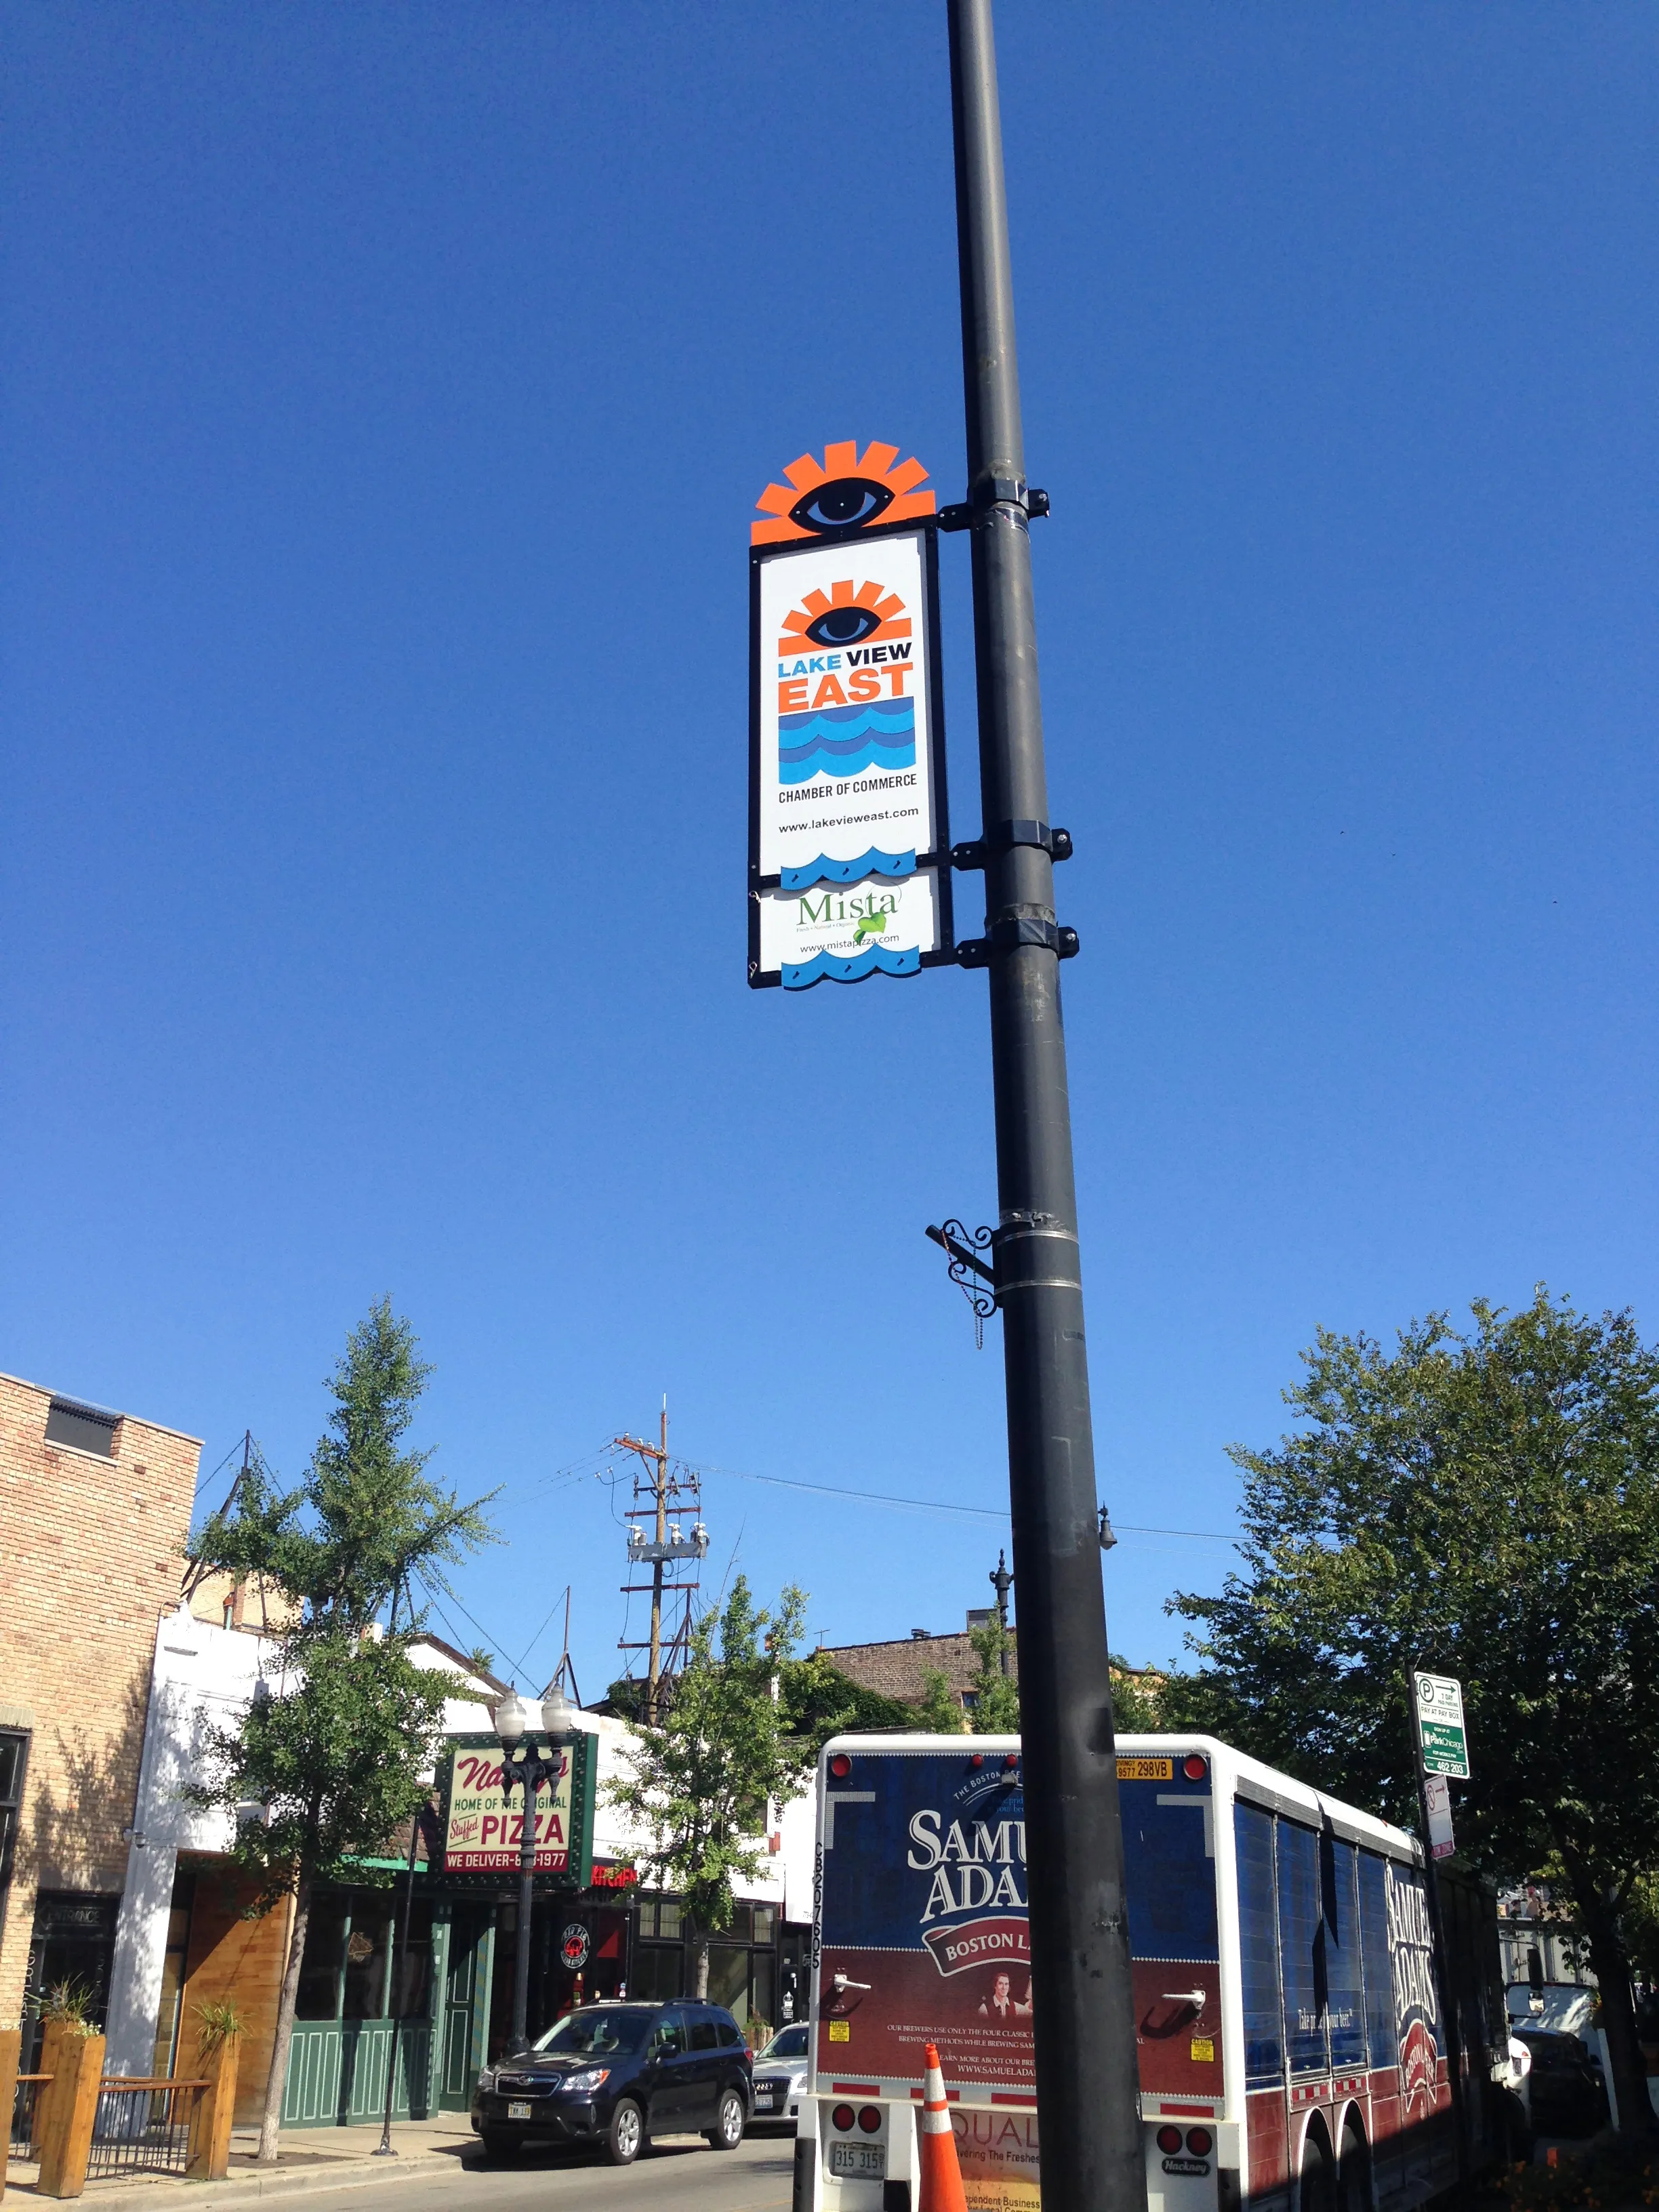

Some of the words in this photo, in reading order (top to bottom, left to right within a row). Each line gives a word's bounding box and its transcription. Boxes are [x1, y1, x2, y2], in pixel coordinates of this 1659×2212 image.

[778, 653, 842, 678] LAKE
[846, 642, 912, 667] VIEW
[778, 662, 914, 714] EAST
[779, 783, 833, 804] CHAMBER
[836, 782, 851, 796] OF
[853, 773, 918, 793] COMMERCE
[779, 807, 919, 834] www.lakevieweast.com
[796, 891, 899, 926] Mista
[800, 935, 899, 953] www.mistapizza.com
[1449, 1712, 1460, 1720] BOX
[1430, 1734, 1463, 1750] ParkChicago
[1137, 1761, 1168, 1777] 298VB
[1437, 1761, 1450, 1772] 462
[1451, 1763, 1464, 1774] 203
[954, 1786, 970, 1800] THE
[455, 1798, 483, 1811] HOME
[485, 1798, 498, 1811] OF
[449, 1816, 479, 1841] Stuffed
[481, 1814, 564, 1845] PIZZA
[447, 1854, 463, 1867] WE
[919, 1864, 1029, 1924] ADA
[813, 1842, 823, 1969] CB207605
[945, 1933, 1014, 1961] BOSTON
[903, 2025, 933, 2033] BREWERS
[983, 2029, 1001, 2037] FOUR
[1002, 2030, 1030, 2039] CLASSIC
[958, 2065, 1037, 2077] WWW.SAMUELADA
[949, 2111, 1040, 2148] QUAL
[836, 2150, 855, 2167] 315
[859, 2152, 878, 2169] 315
[989, 2150, 1004, 2160] The
[1006, 2151, 1040, 2164] Freshes
[1165, 2160, 1207, 2175] Hackney
[964, 2195, 1001, 2206] ependent
[1003, 2196, 1040, 2209] Business
